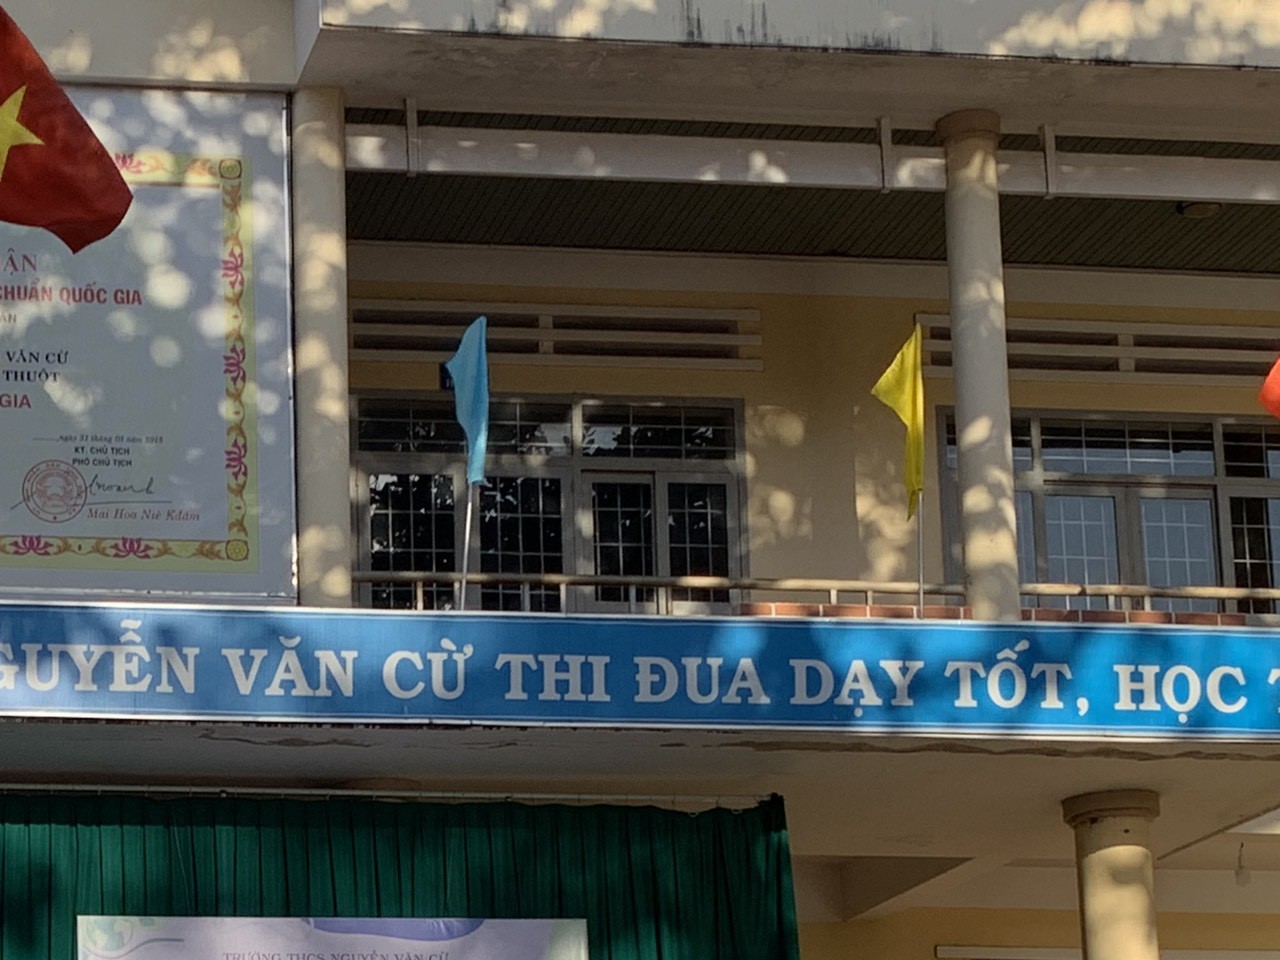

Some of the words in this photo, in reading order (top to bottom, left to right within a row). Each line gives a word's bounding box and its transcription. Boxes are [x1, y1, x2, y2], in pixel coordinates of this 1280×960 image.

[59, 280, 108, 306] QUỐC
[113, 289, 143, 306] GIA
[6, 347, 41, 363] VĂN
[46, 348, 70, 365] CỪ
[111, 447, 130, 457] TỊCH
[113, 458, 132, 468] TỊCH
[87, 508, 109, 520] Mai
[222, 635, 359, 698] VĂN
[382, 637, 474, 701] CỪ
[495, 653, 611, 703] THI
[632, 656, 771, 705] ĐUA
[790, 658, 924, 718] DẠY
[945, 638, 1090, 717] TỐT,
[1113, 663, 1249, 724] HỌC
